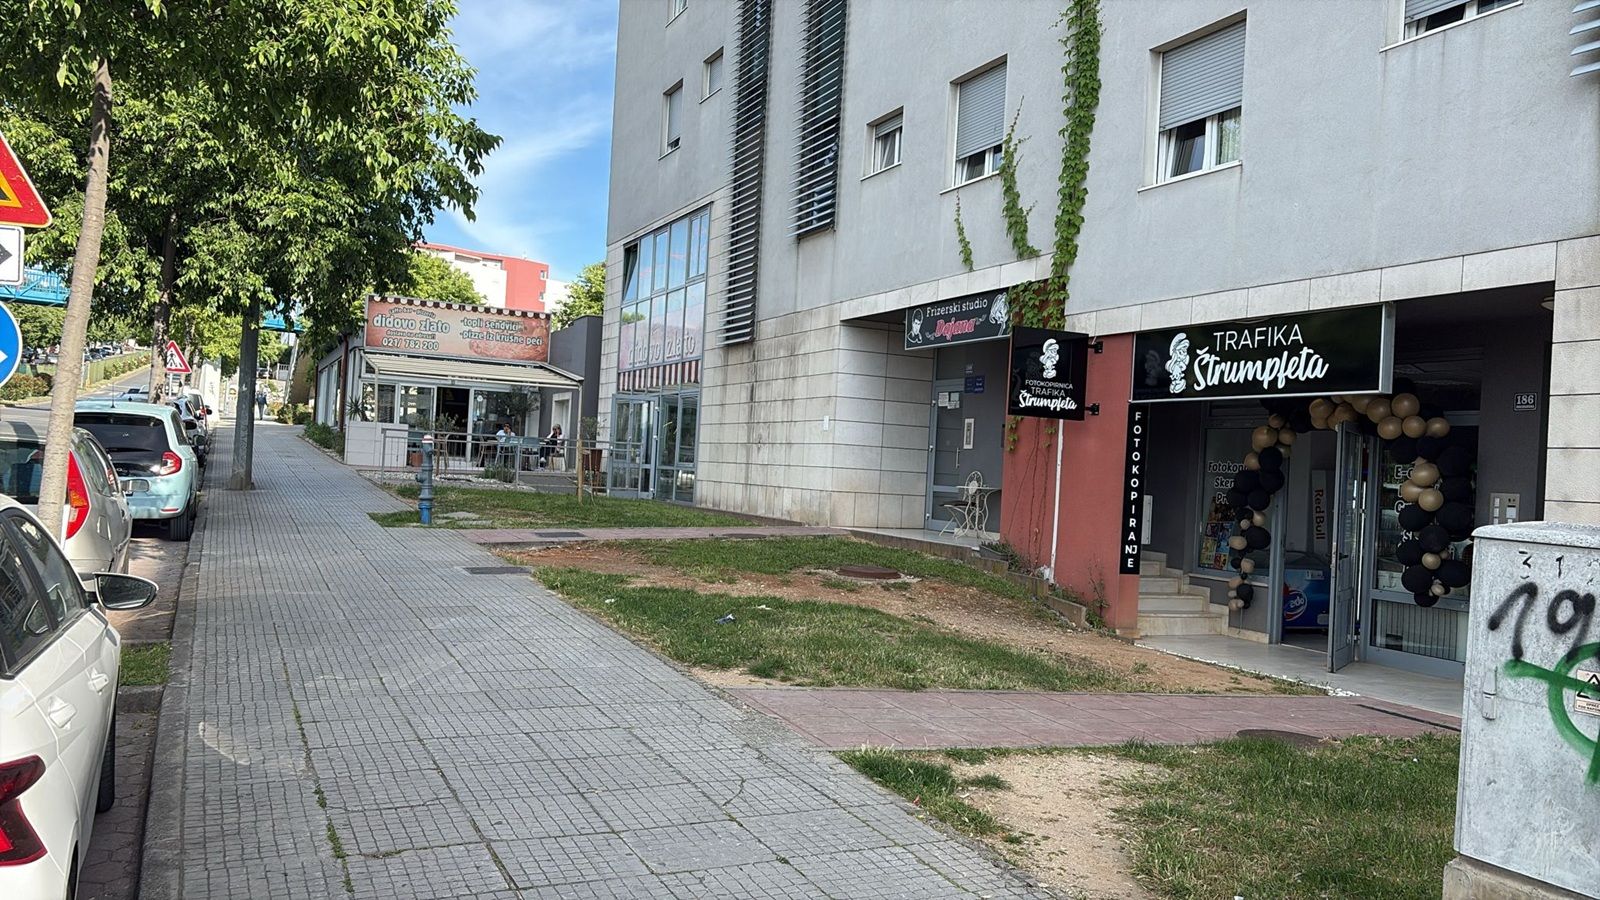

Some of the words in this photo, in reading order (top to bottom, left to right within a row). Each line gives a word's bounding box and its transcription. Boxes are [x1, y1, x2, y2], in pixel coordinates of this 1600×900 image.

[926, 303, 961, 318] Frizerski
[962, 298, 988, 312] studio
[374, 313, 416, 330] didovo
[419, 318, 450, 334] zlato
[935, 316, 977, 341] Dajana
[404, 339, 420, 349] 782
[422, 340, 439, 351] 200
[486, 331, 494, 340] iz
[1213, 323, 1304, 352] TRAFIKA
[1193, 346, 1330, 392] Štrumpfeta
[1025, 379, 1074, 391] FOTOKOPIRNICA
[1031, 386, 1066, 398] TRAFIKA
[1018, 389, 1078, 412] Štrumpfeta
[1516, 394, 1534, 405] 186
[1124, 411, 1142, 569] FOTOKOPIRANJE
